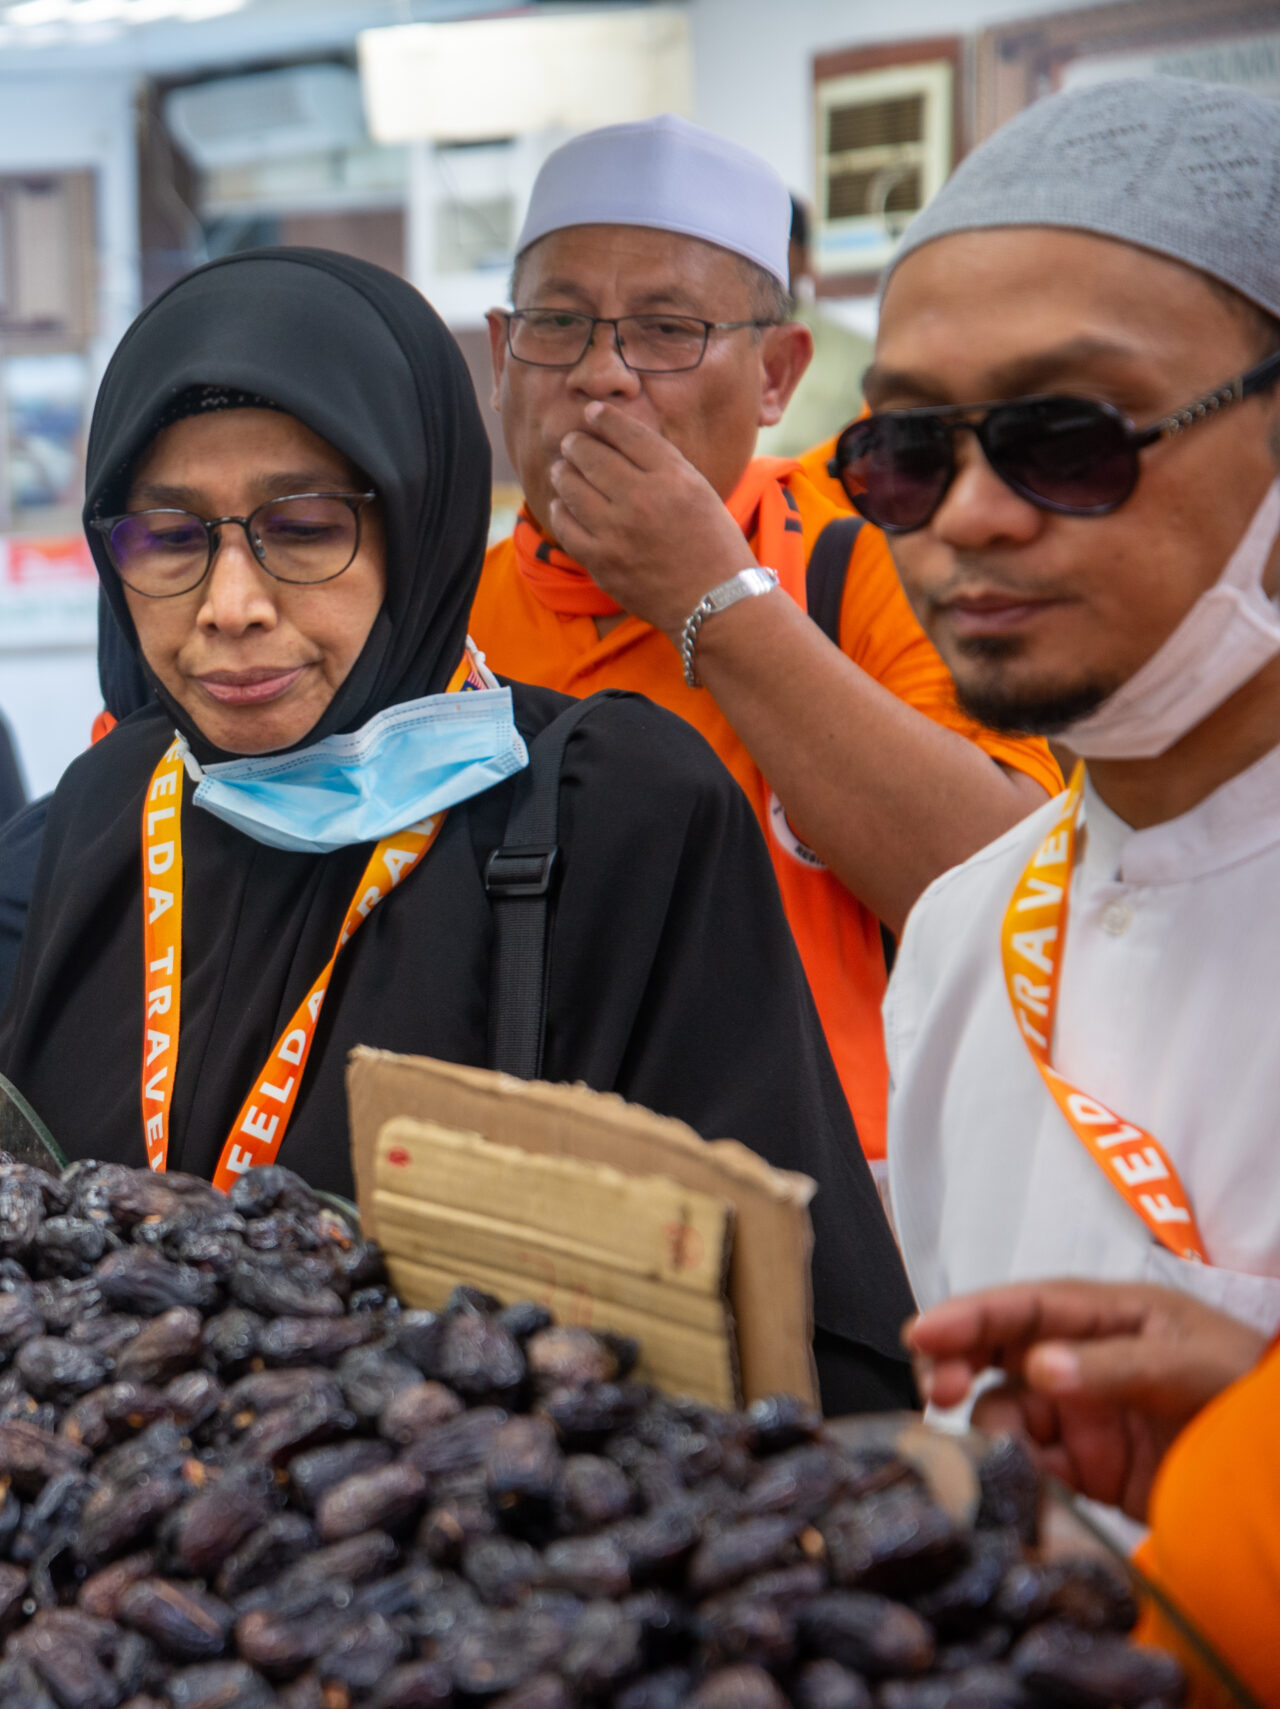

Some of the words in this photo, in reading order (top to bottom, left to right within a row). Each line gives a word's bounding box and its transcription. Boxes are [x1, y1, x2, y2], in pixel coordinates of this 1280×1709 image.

[147, 742, 180, 924] FELDA
[226, 988, 326, 1175] FELDA
[1064, 1092, 1191, 1223] FELD
